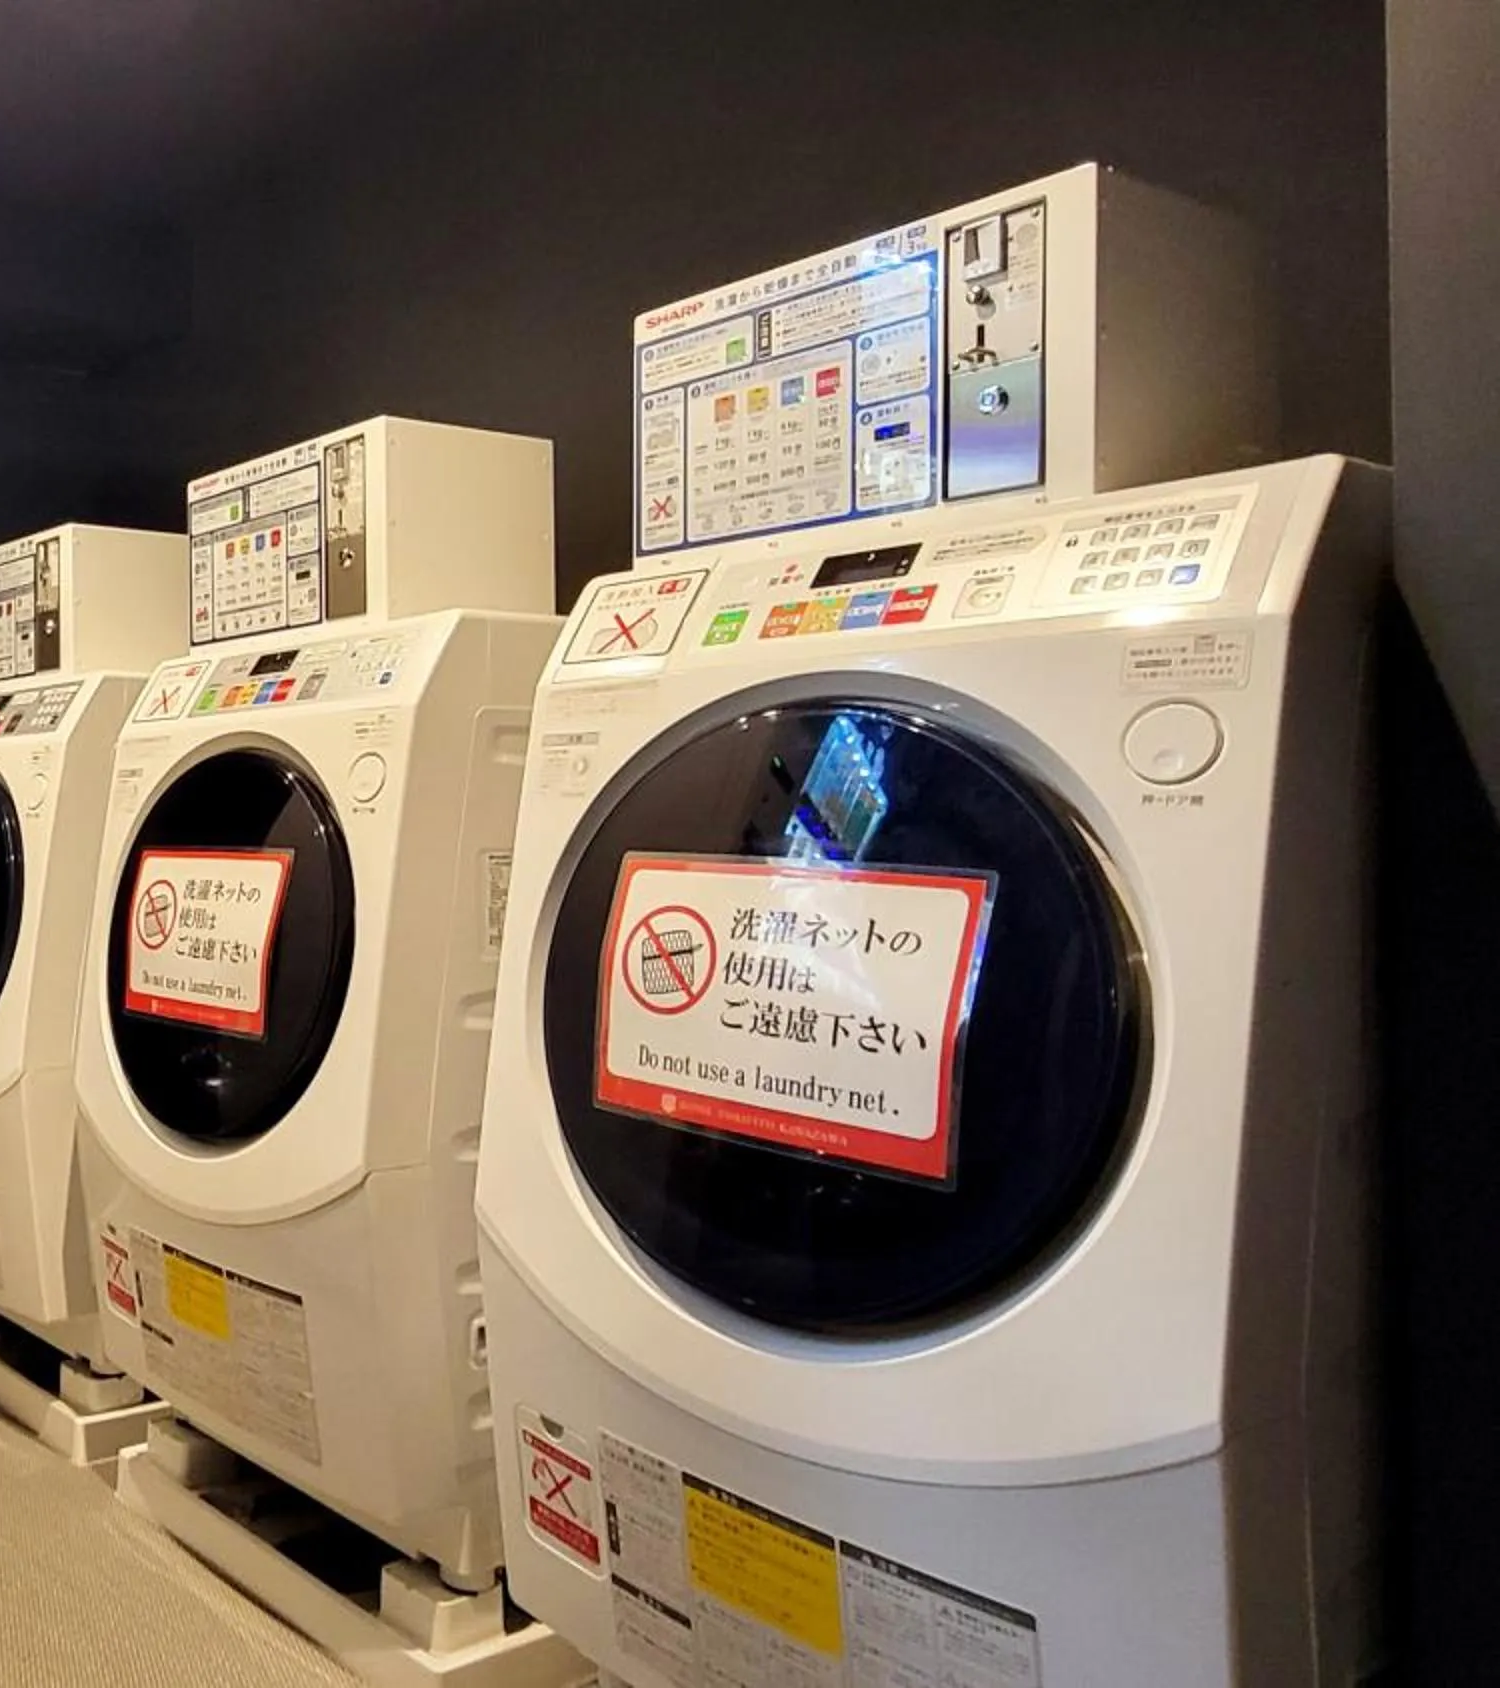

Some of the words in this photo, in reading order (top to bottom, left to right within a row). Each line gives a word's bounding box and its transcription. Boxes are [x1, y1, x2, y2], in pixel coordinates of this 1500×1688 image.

[644, 301, 705, 329] SHARP
[183, 879, 261, 904] 洗濯ネットの
[178, 908, 217, 929] 使用は
[731, 906, 923, 957] 洗濯ネットの
[175, 935, 257, 963] ご遠慮下さい
[723, 952, 817, 994] 使用は
[719, 998, 928, 1055] ご遠慮下さい
[638, 1043, 659, 1068] Do
[663, 1047, 691, 1076] not
[697, 1060, 730, 1083] use
[733, 1069, 746, 1087] a
[755, 1065, 843, 1109] laundry
[848, 1088, 901, 1116] net.
